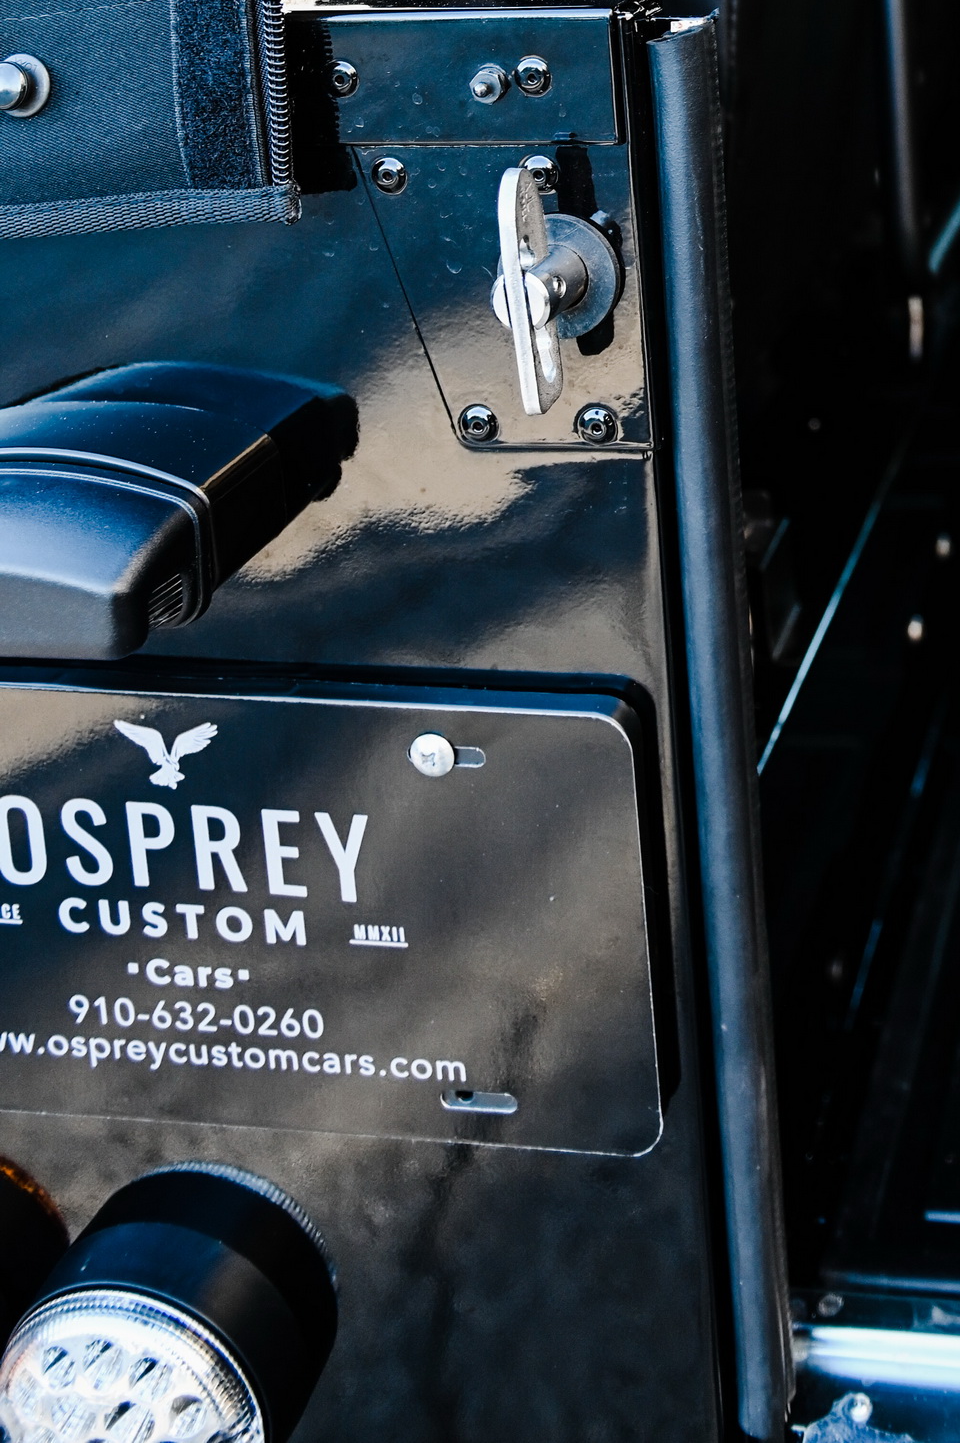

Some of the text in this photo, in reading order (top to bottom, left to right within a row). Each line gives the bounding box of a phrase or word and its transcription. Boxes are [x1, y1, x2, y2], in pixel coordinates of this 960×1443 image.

[0, 794, 368, 904] OSPREY
[58, 897, 307, 946] CUSTOM
[353, 923, 405, 943] MMXII
[68, 995, 325, 1040] 910-632-0260
[0, 1031, 467, 1083] w.ospreycustomcars.com
